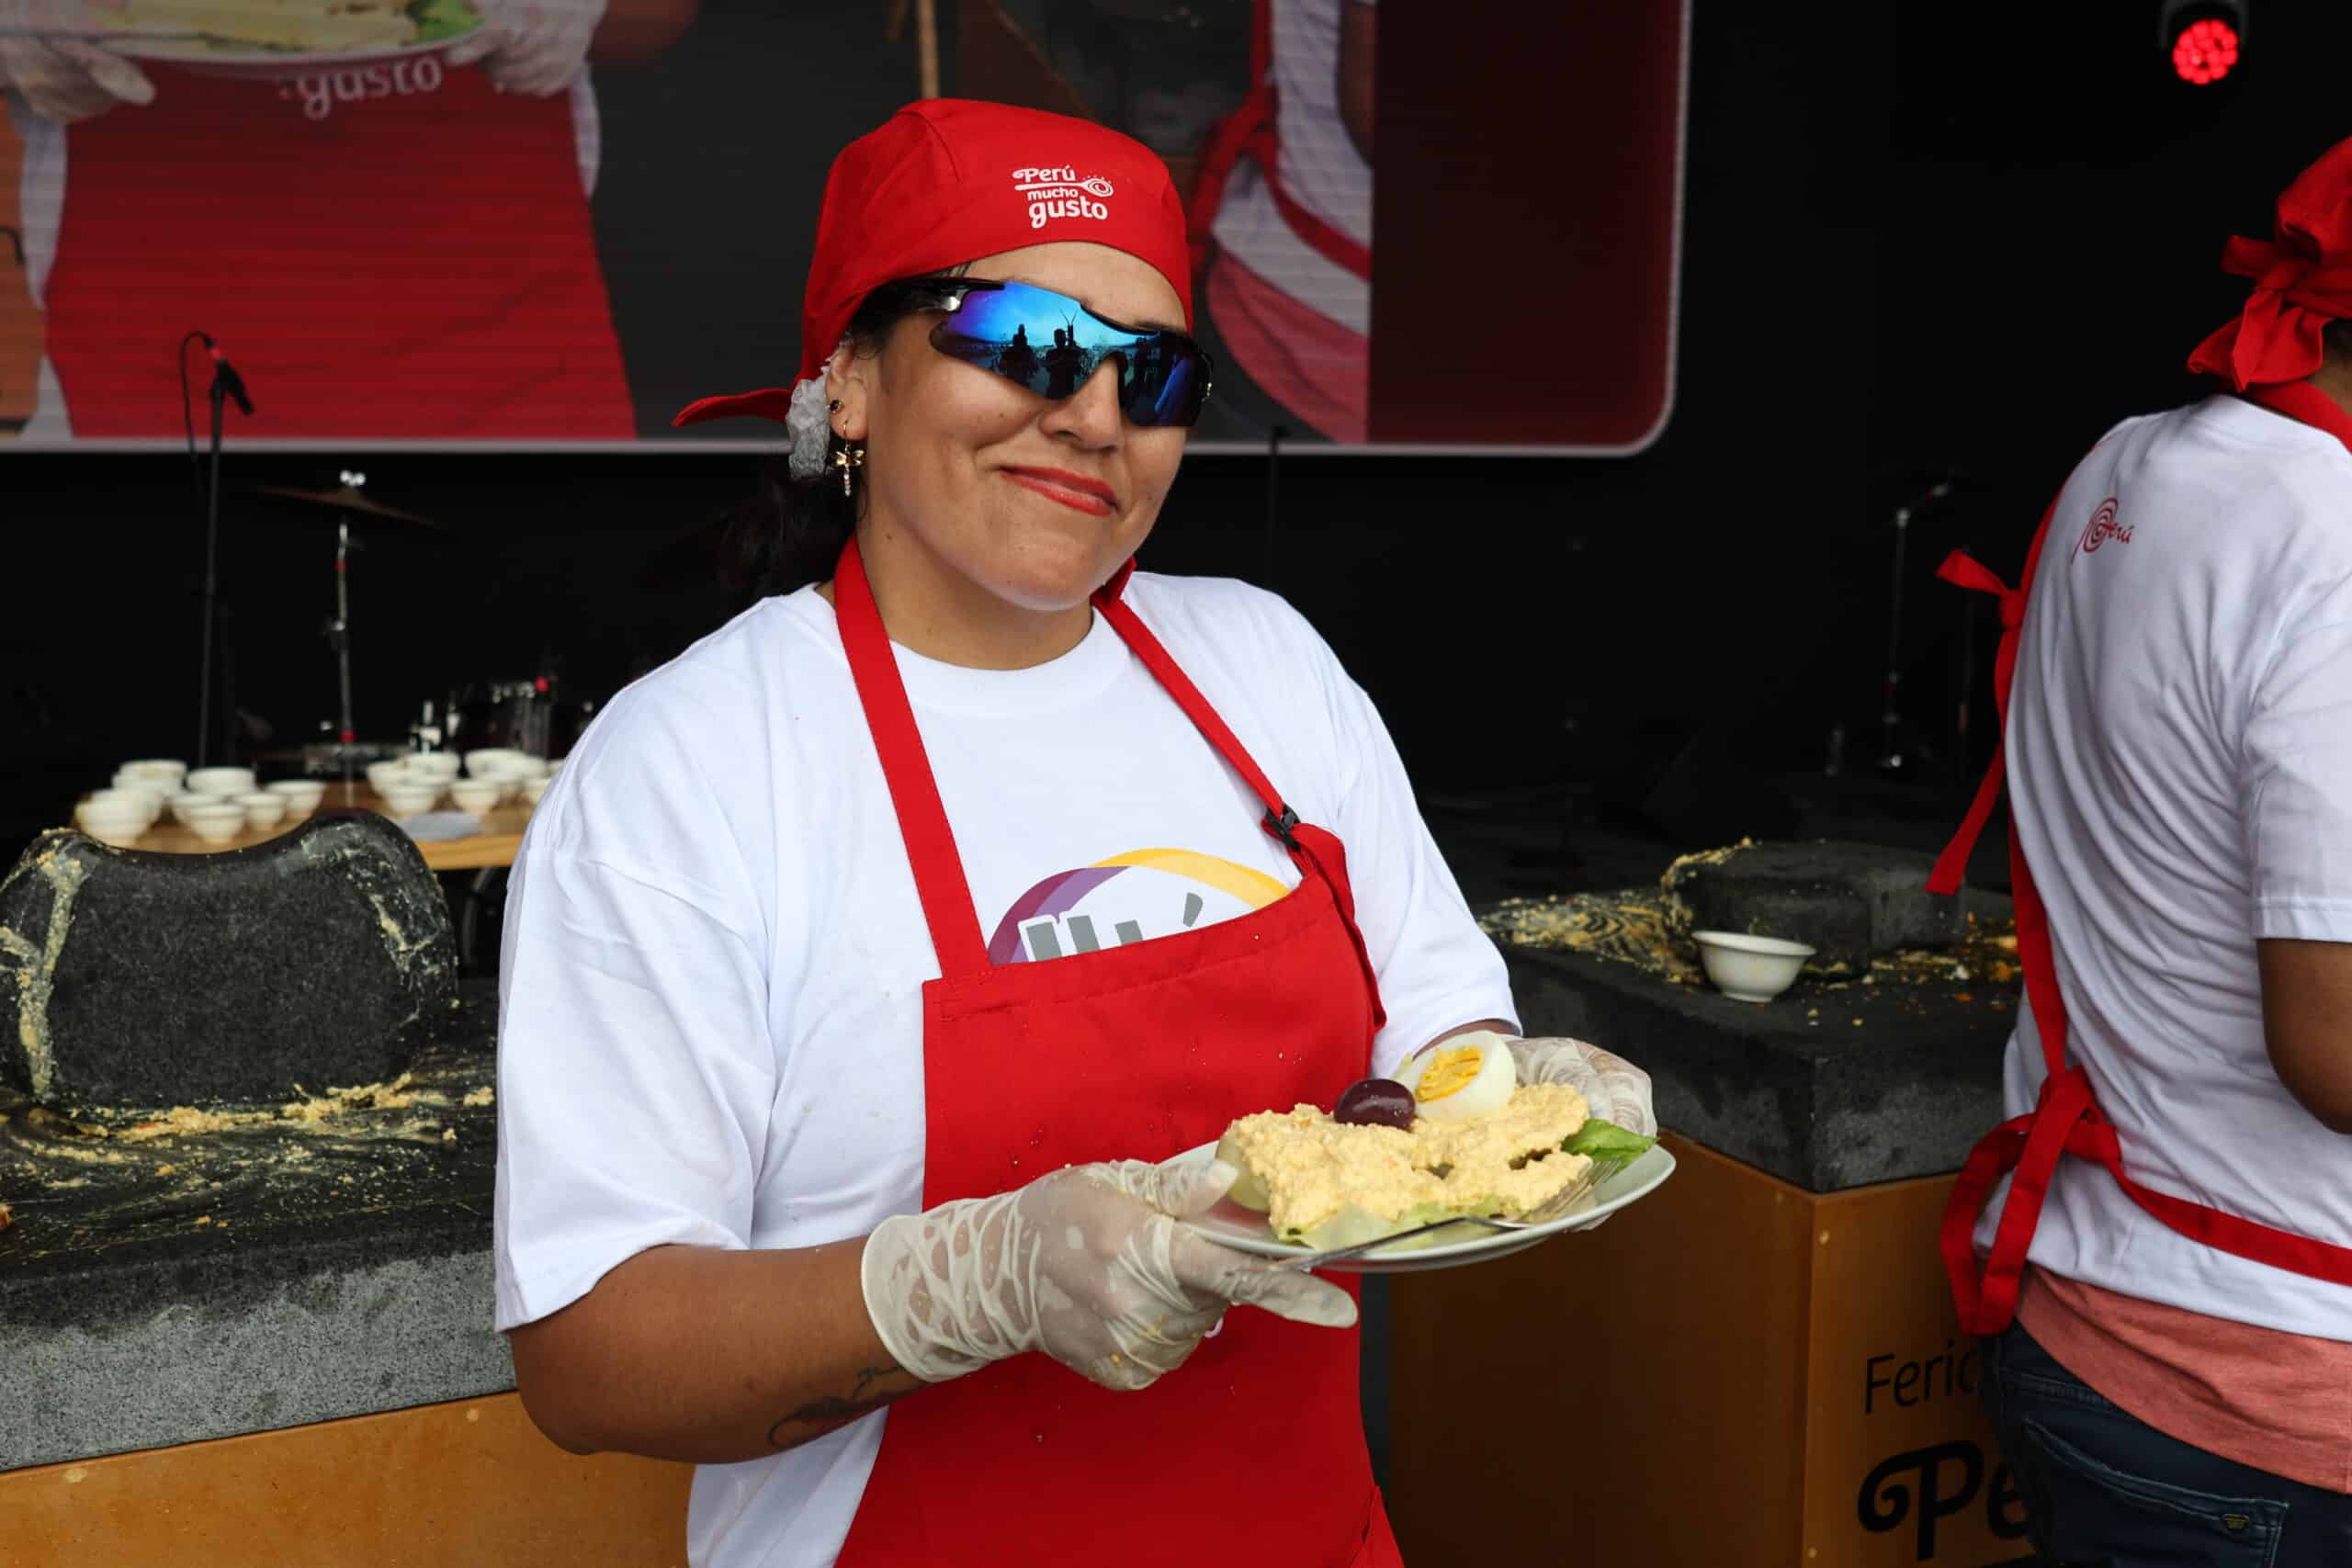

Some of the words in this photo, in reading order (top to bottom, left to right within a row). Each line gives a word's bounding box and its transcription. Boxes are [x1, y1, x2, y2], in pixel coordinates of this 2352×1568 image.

[1012, 164, 1076, 182] Perú
[1027, 187, 1079, 200] mucho
[1028, 196, 1108, 229] gusto
